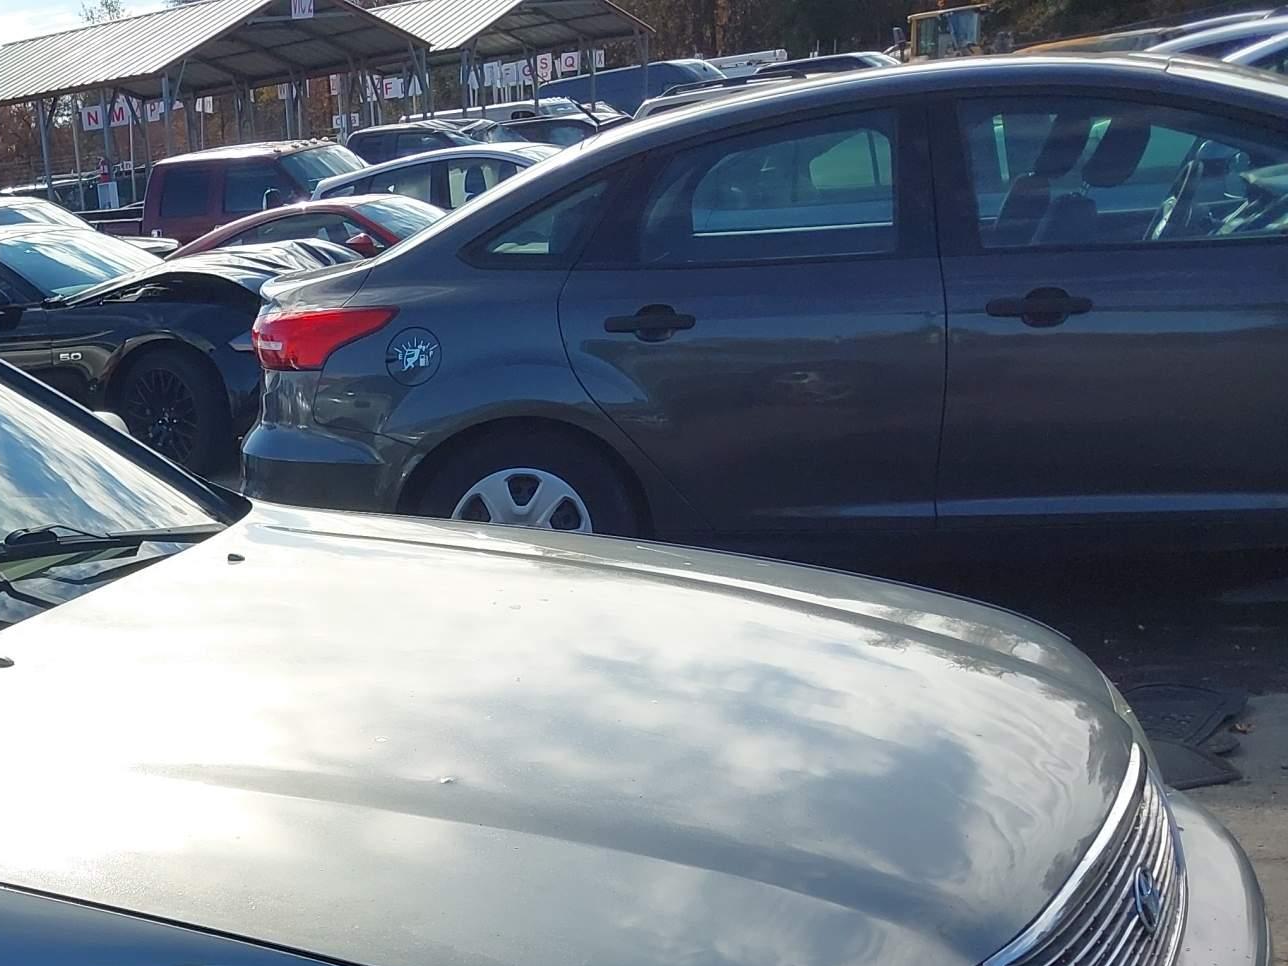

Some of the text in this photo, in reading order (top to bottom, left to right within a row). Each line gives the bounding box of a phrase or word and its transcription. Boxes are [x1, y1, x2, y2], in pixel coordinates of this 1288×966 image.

[539, 57, 549, 70] S
[564, 55, 575, 68] Q
[384, 82, 393, 96] F
[87, 111, 99, 127] N
[112, 106, 125, 122] M
